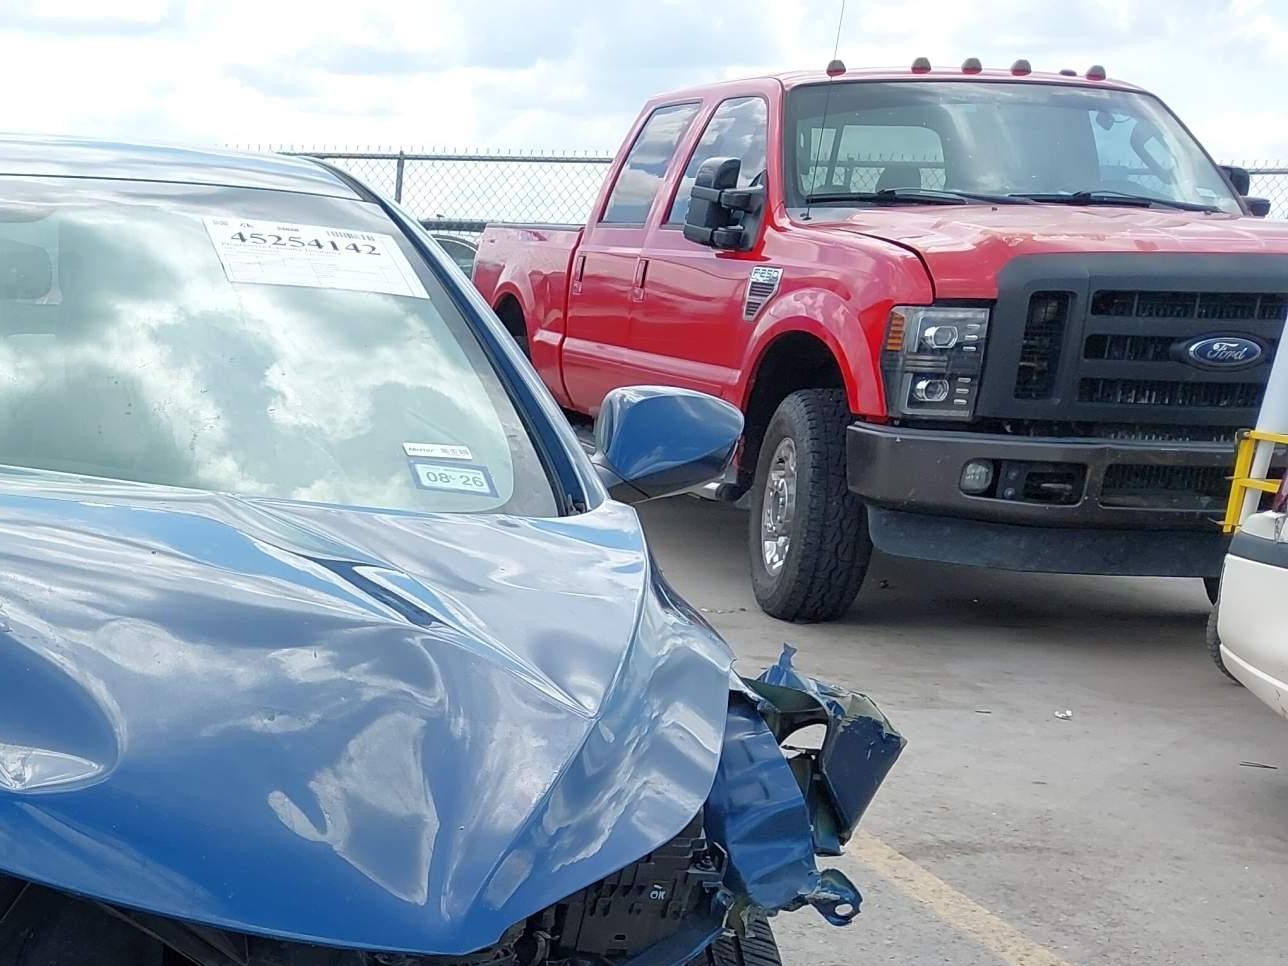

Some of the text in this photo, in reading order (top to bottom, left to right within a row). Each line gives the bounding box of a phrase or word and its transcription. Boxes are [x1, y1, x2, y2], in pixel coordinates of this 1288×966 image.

[230, 231, 381, 256] 45254142
[1207, 342, 1248, 360] Ford
[425, 471, 484, 488] 08 26
